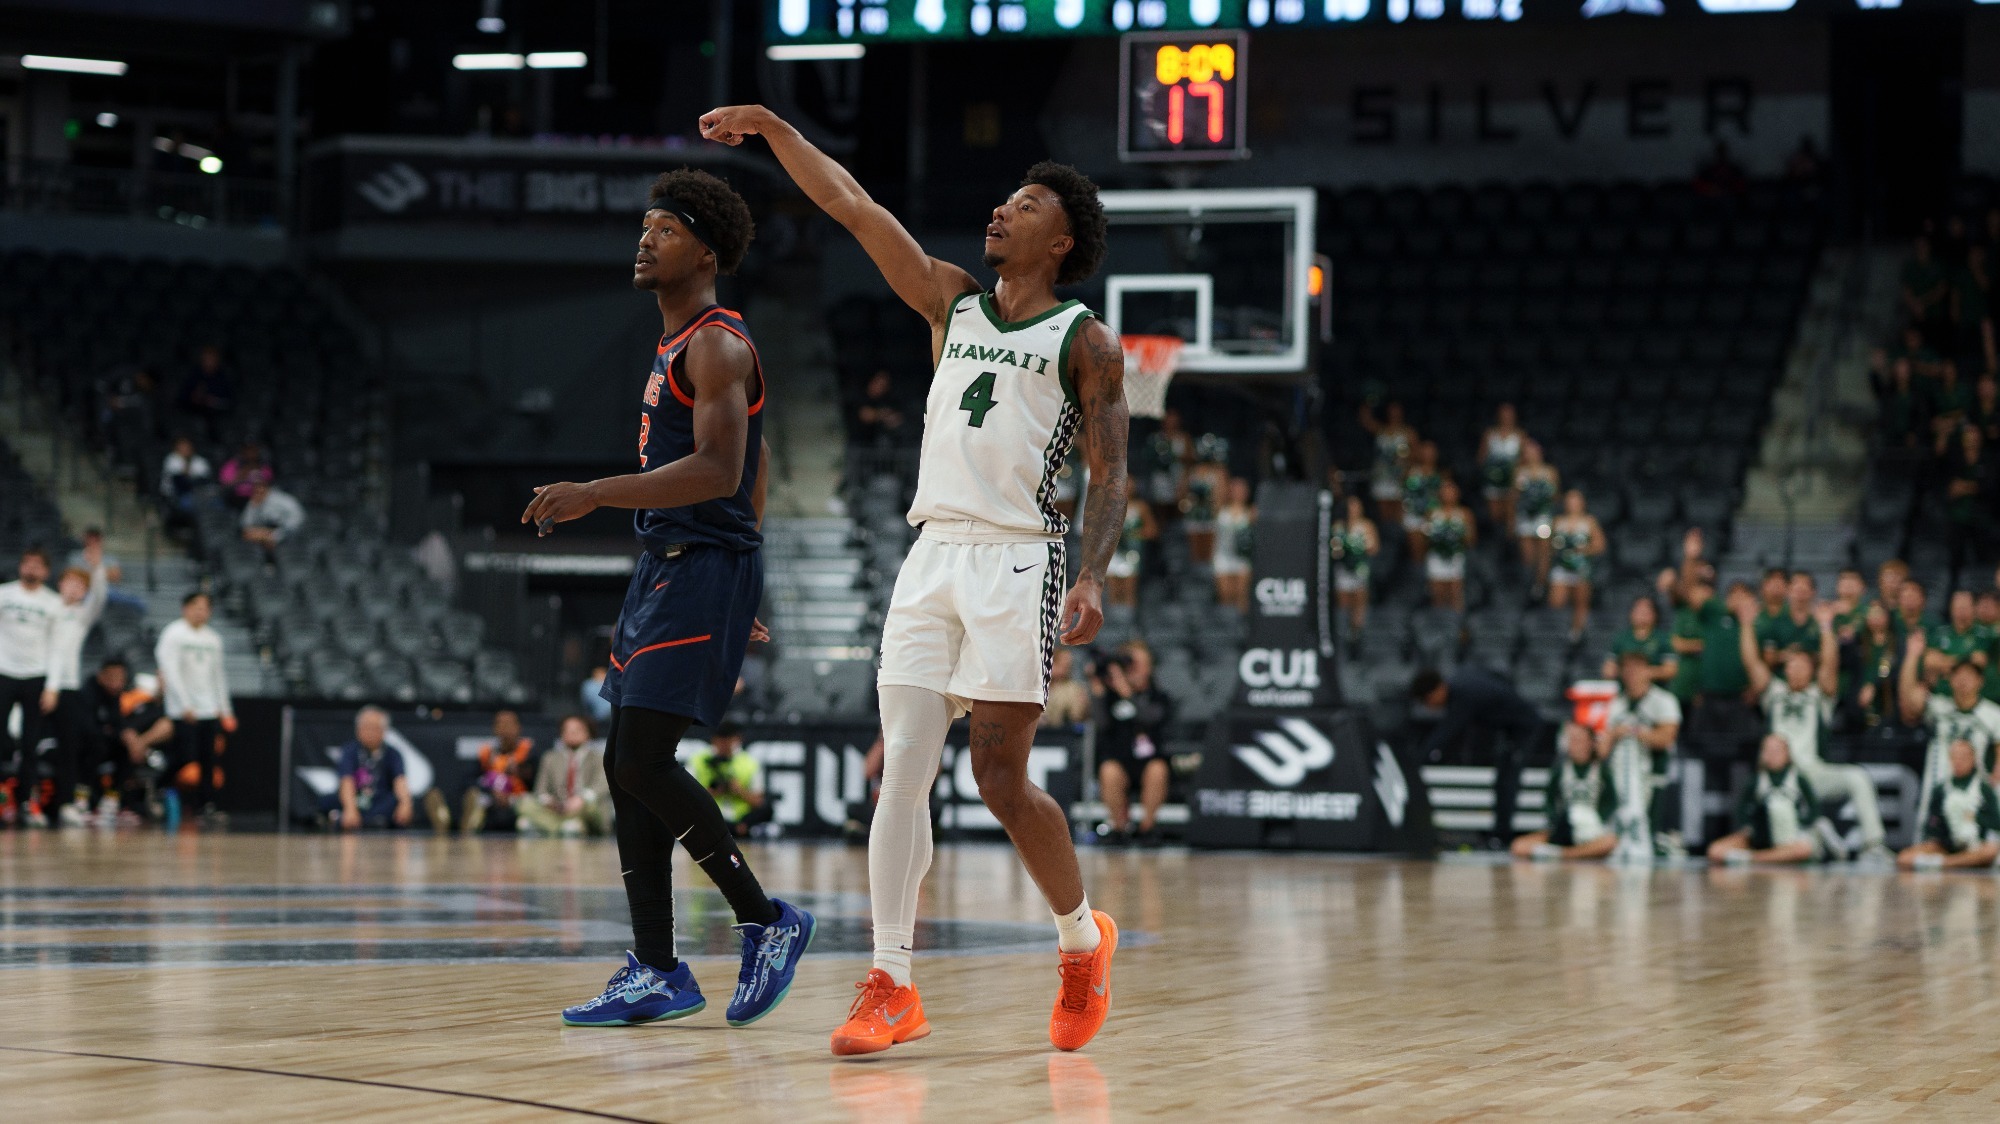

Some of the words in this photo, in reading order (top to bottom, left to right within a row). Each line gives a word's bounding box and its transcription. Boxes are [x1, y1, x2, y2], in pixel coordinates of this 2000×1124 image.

[1157, 44, 1235, 85] 8:09
[1168, 81, 1224, 144] 17
[1351, 77, 1755, 144] SILVER
[959, 371, 998, 428] 4
